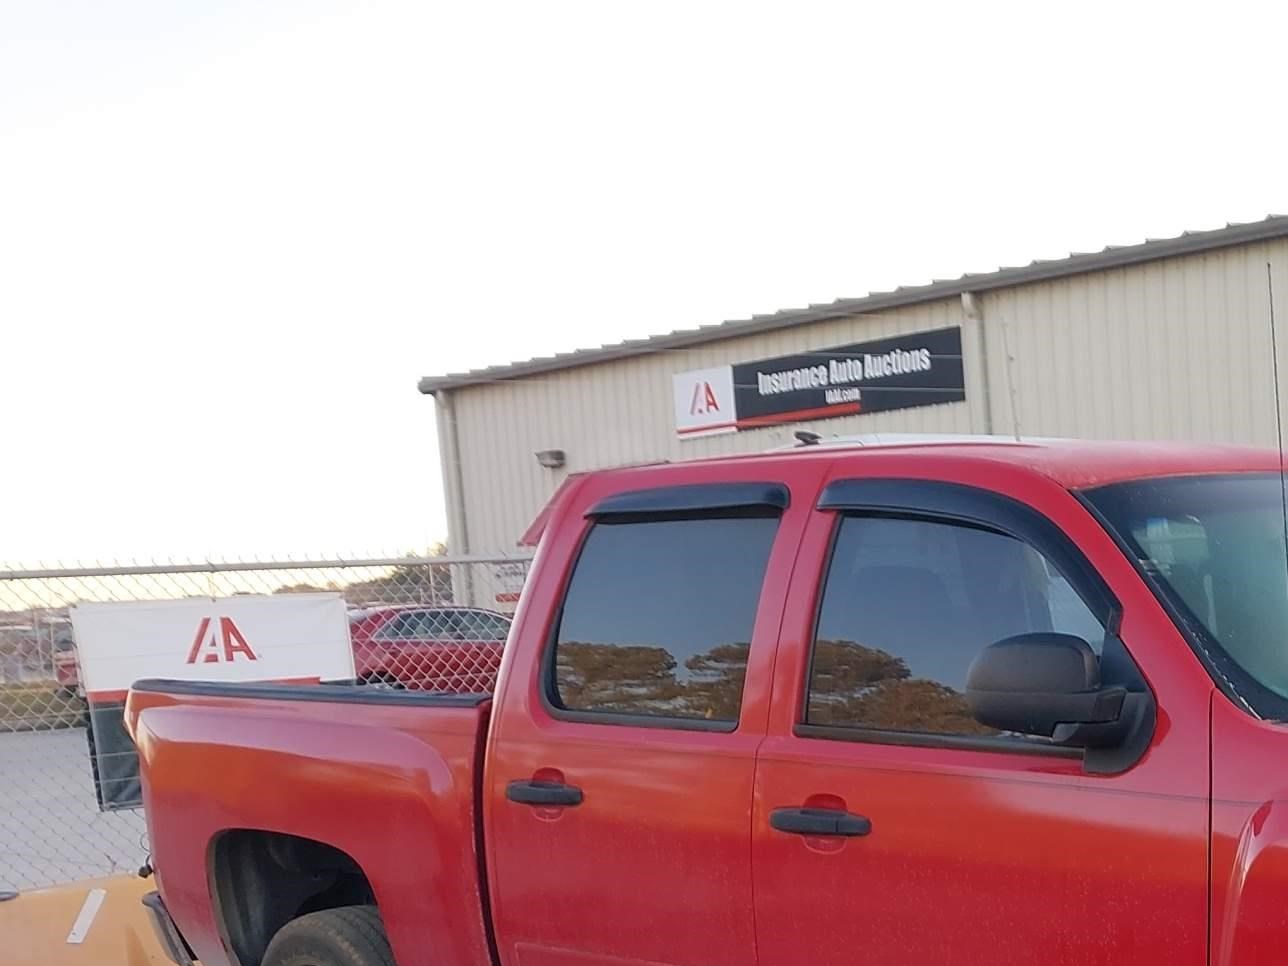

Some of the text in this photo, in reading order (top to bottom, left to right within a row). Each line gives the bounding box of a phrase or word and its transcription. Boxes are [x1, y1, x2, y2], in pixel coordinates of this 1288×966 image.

[757, 348, 931, 396] Insurance Auto Auctions
